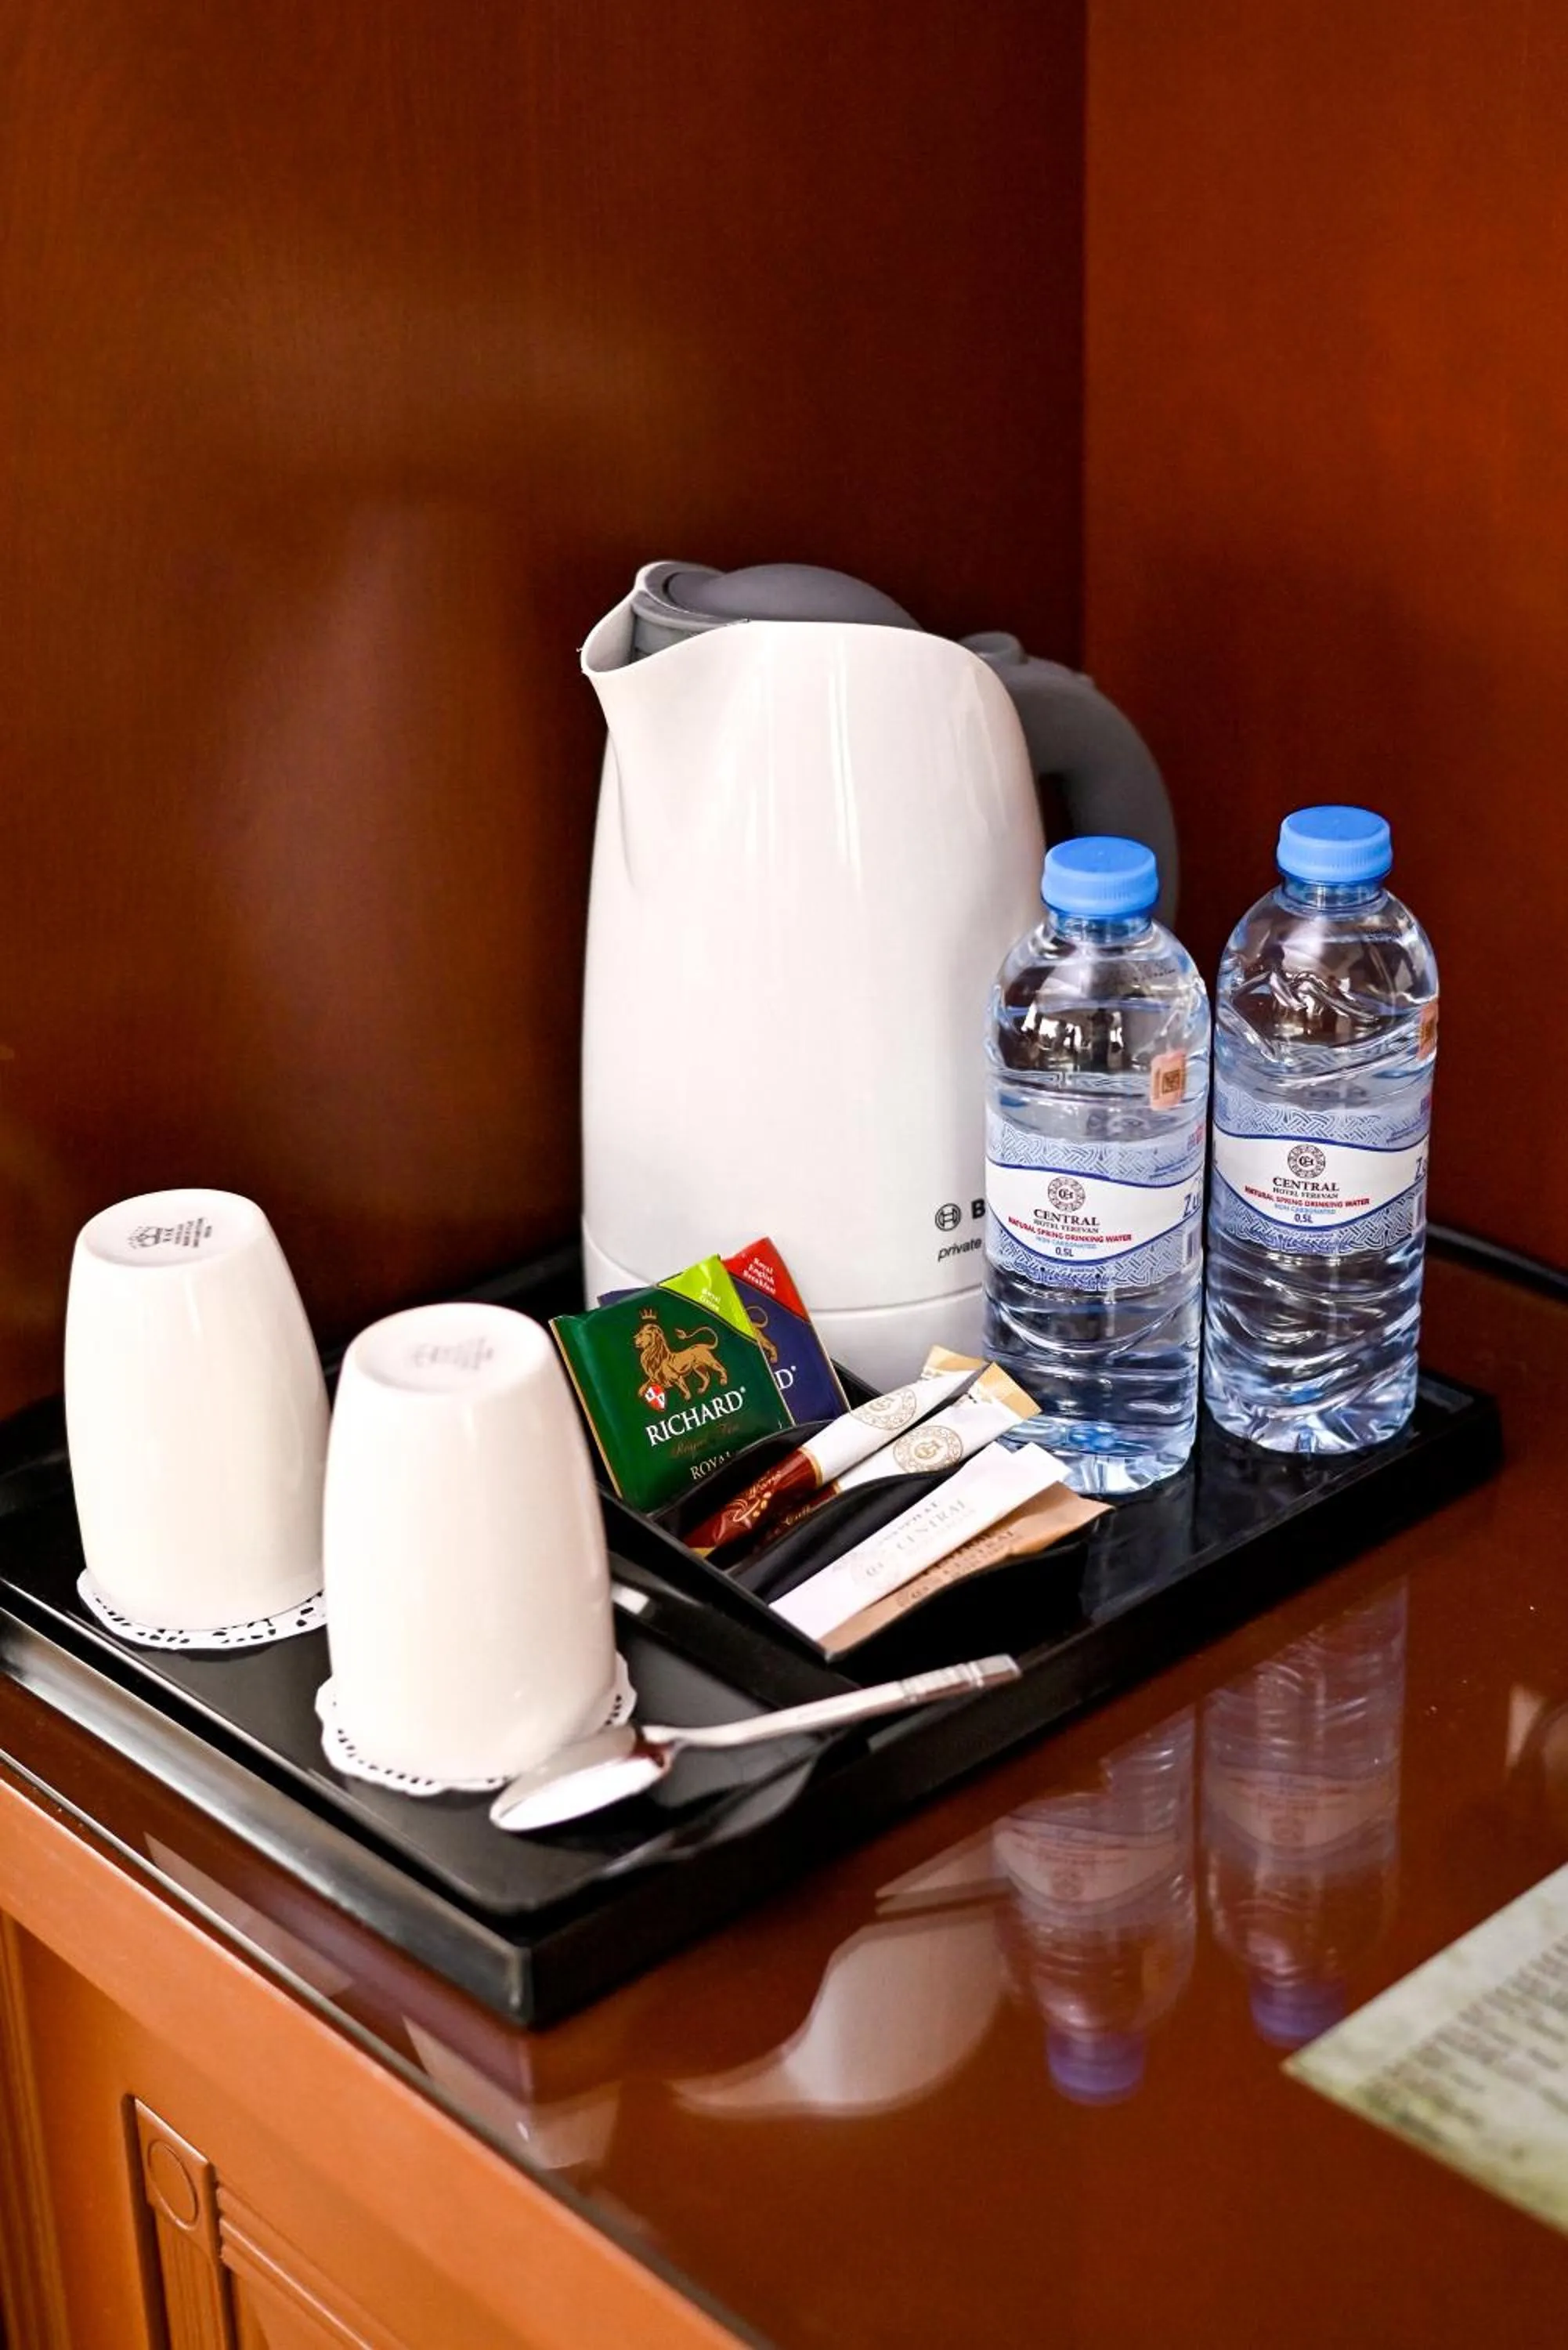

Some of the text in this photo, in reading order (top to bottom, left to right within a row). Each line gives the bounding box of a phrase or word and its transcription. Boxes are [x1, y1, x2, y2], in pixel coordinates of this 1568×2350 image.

[1273, 1177, 1339, 1191] CENTRAL
[1273, 1187, 1339, 1199] HOTEL YEREVAN
[1245, 1185, 1370, 1209] NATURAL SPRING DRINKING WATER
[971, 1198, 986, 1219] B
[1033, 1209, 1100, 1226] CENTRAL
[1008, 1216, 1132, 1243] NATURAL SPRING DRINKING WATER
[1033, 1218, 1099, 1234] HOTEL YEREVAN
[938, 1238, 982, 1262] private
[748, 1263, 775, 1285] English
[753, 1256, 774, 1275] Royal
[742, 1269, 776, 1295] Breakfast
[645, 1390, 743, 1447] RICHARD
